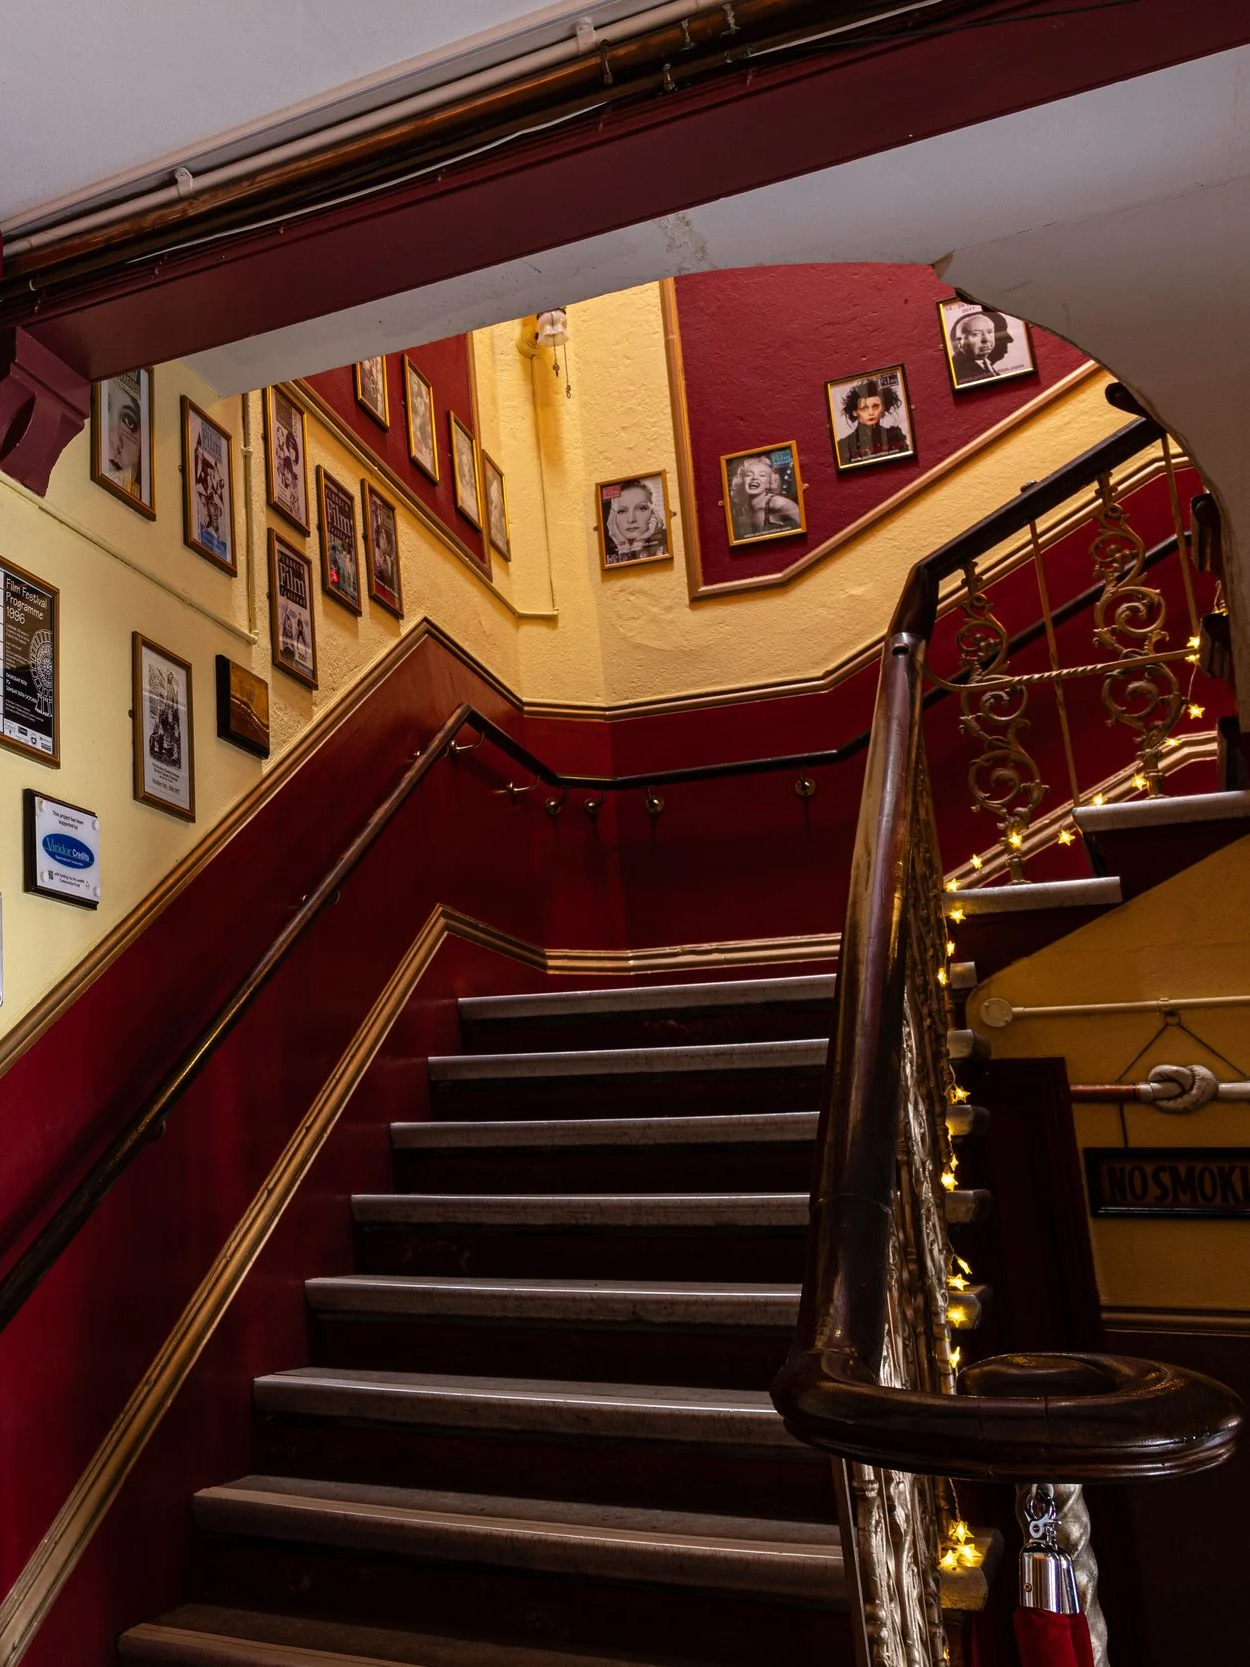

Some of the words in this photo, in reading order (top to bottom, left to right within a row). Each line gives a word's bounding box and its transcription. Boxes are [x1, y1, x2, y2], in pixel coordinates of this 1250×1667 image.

[326, 497, 351, 536] Film
[6, 578, 21, 595] Film
[22, 586, 48, 609] Festival
[279, 562, 305, 597] Film
[6, 591, 44, 620] Programme
[6, 606, 25, 624] 1996
[46, 837, 72, 856] Viridor
[72, 849, 90, 862] Credits
[1106, 1164, 1148, 1202] NO
[1152, 1164, 1250, 1204] SMOKI
